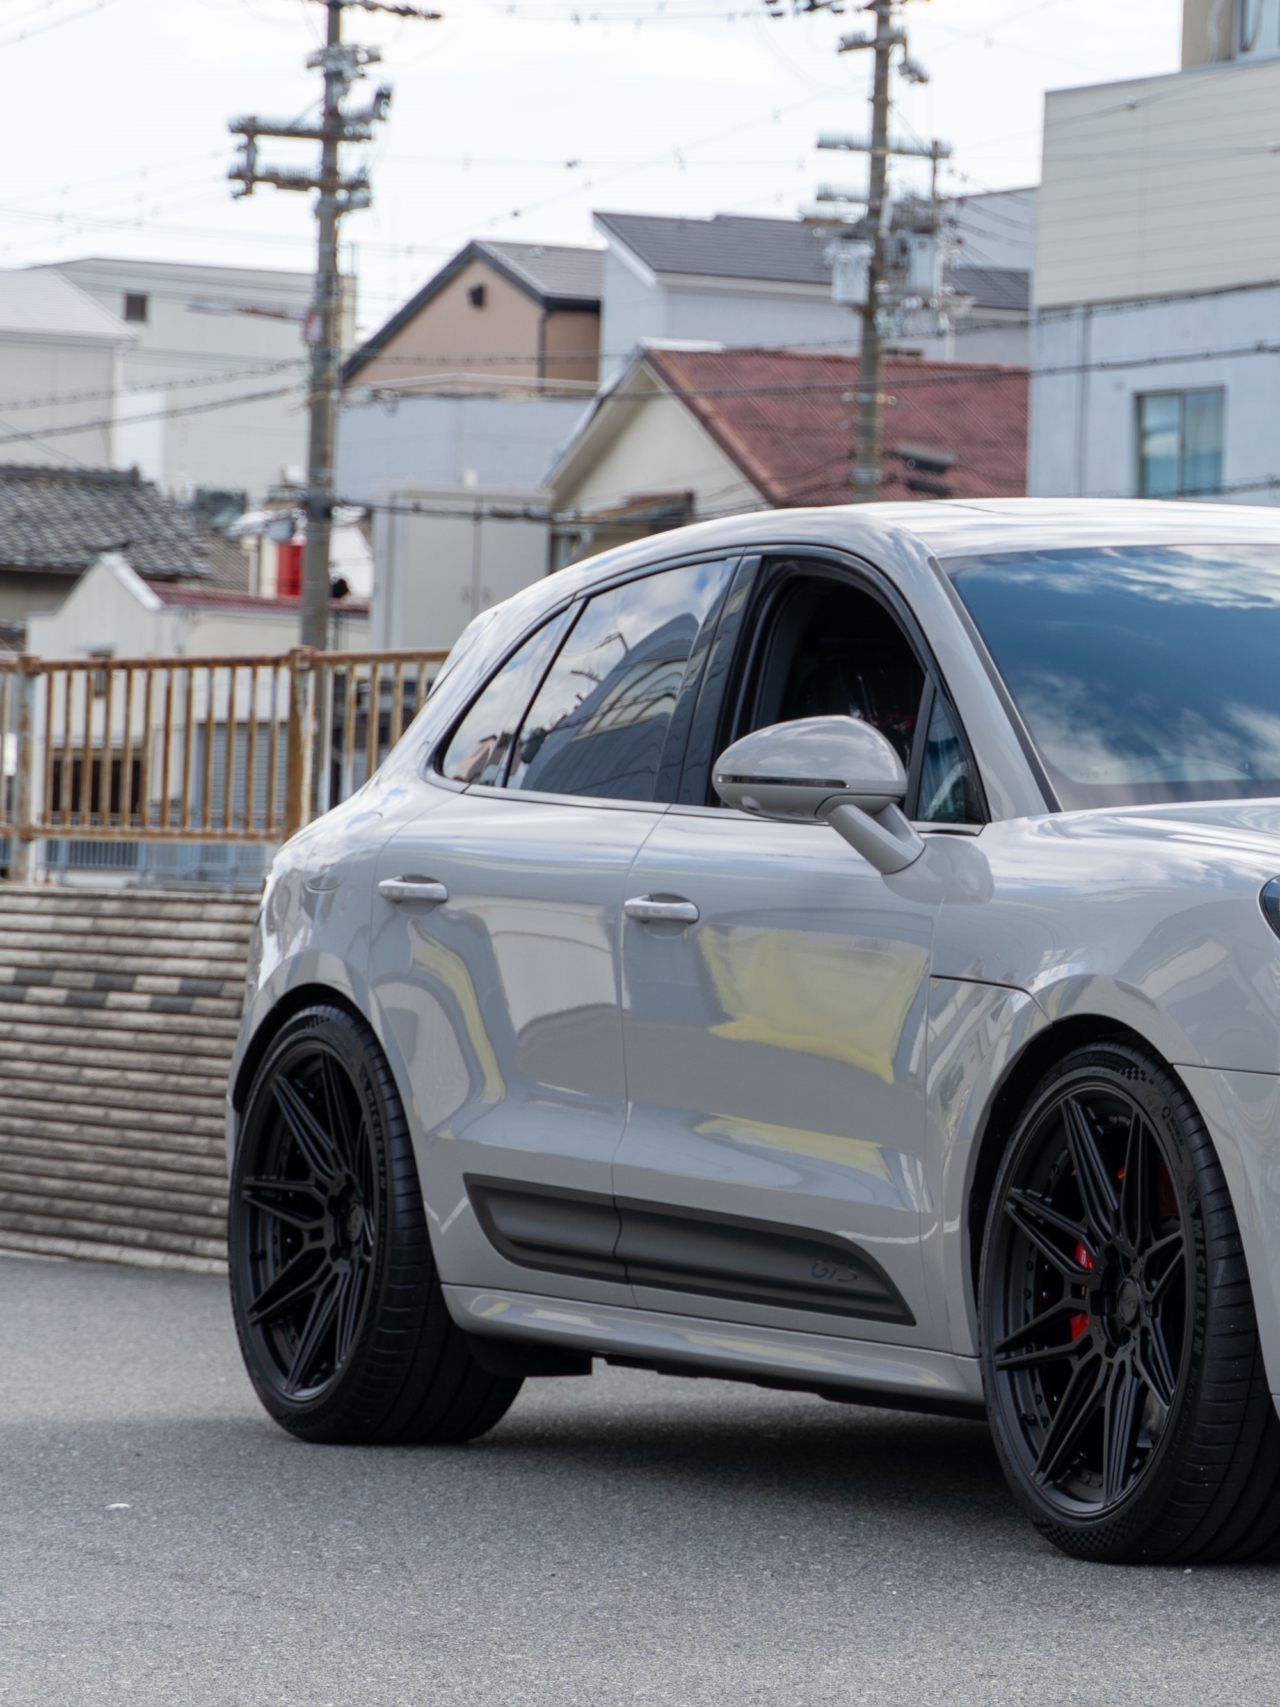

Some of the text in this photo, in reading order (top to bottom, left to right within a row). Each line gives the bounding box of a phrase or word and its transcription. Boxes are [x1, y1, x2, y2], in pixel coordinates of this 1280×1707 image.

[365, 1088, 386, 1189] MICHELIN
[811, 1258, 858, 1283] GTS
[1192, 1218, 1208, 1357] MICHELIN
[1185, 1367, 1198, 1404] PILOT
